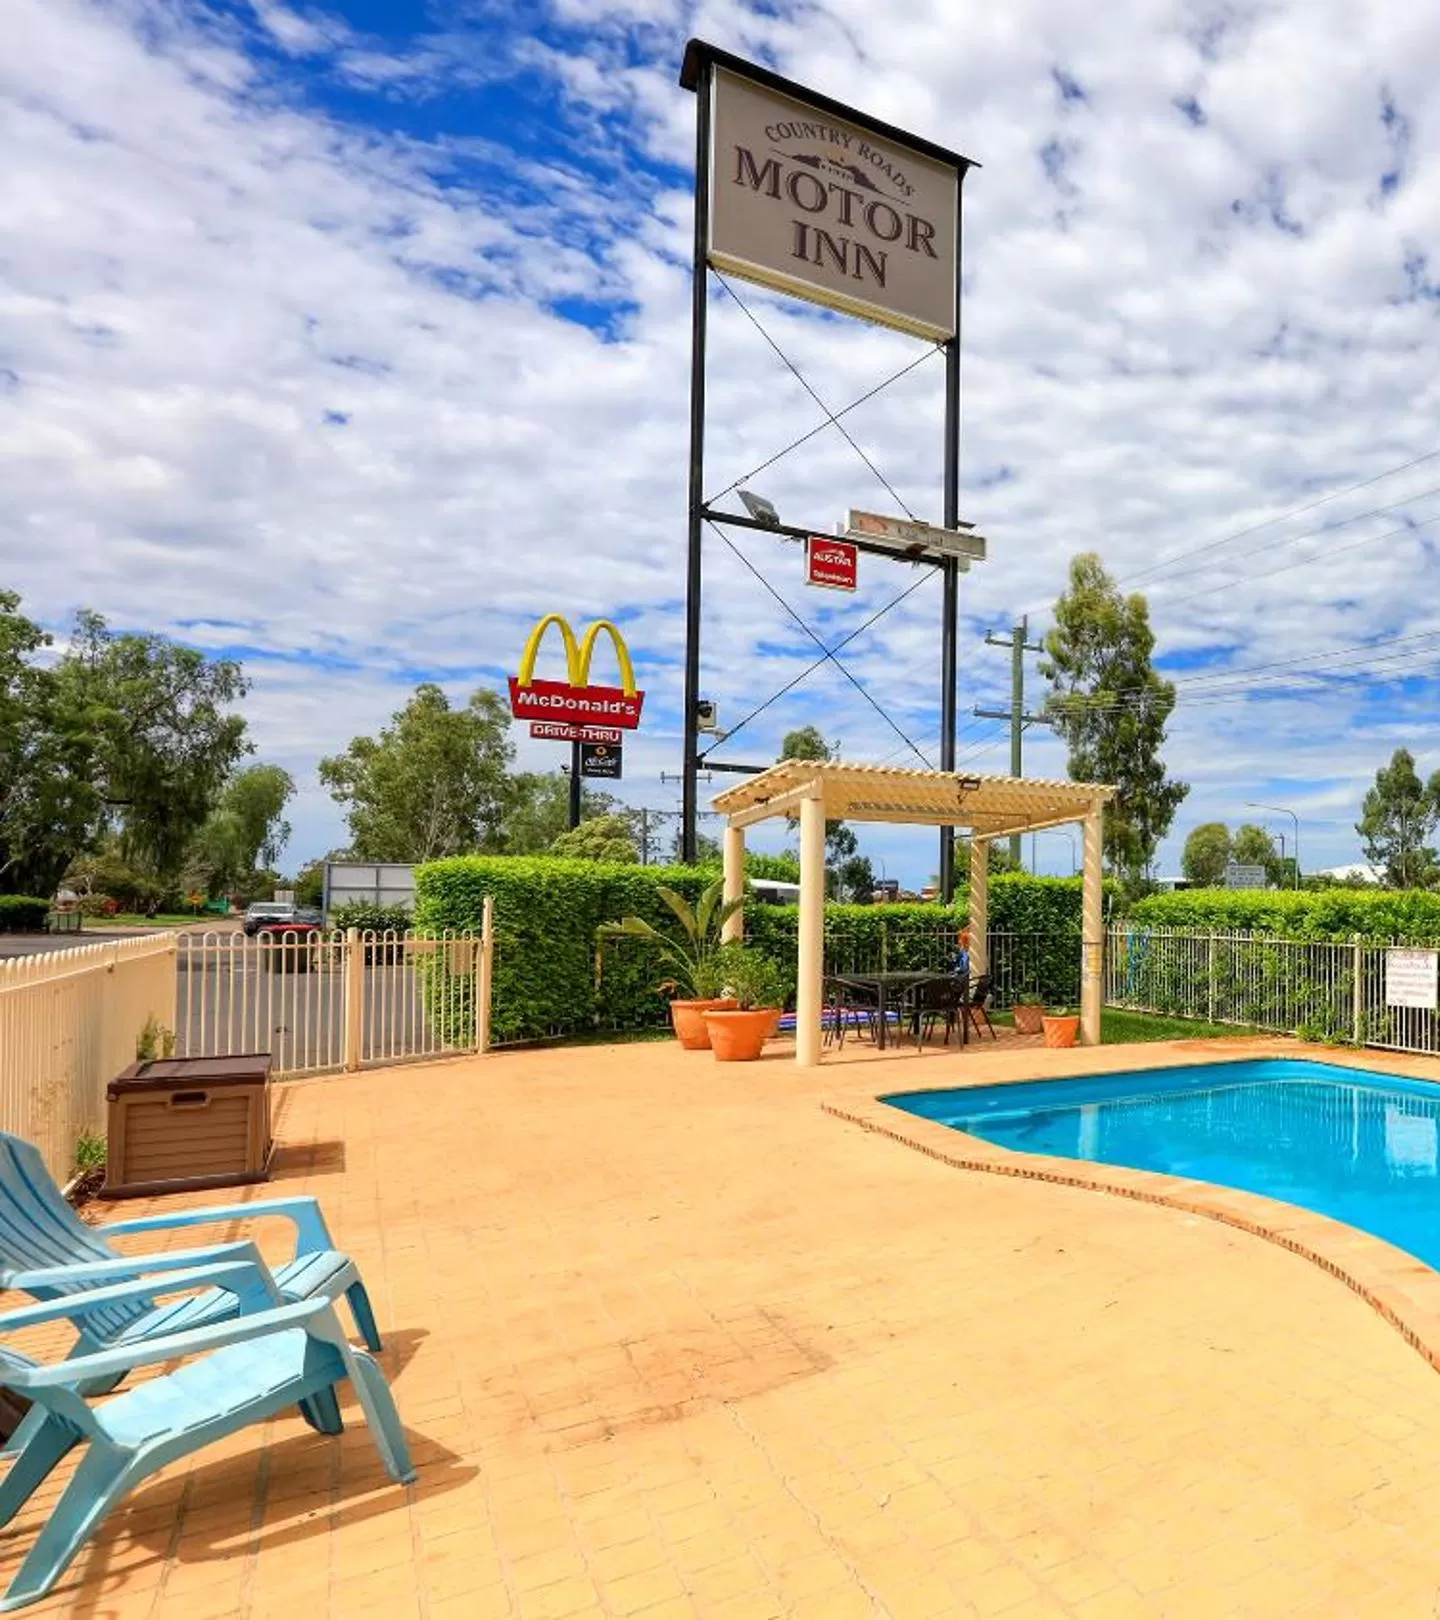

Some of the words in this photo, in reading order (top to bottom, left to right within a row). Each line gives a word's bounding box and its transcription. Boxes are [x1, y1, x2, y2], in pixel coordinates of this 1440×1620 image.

[764, 121, 850, 149] COUNTRY
[857, 143, 916, 198] ROADS
[733, 144, 939, 261] MOTOR
[790, 219, 889, 289] INN
[517, 692, 636, 716] McDonald's
